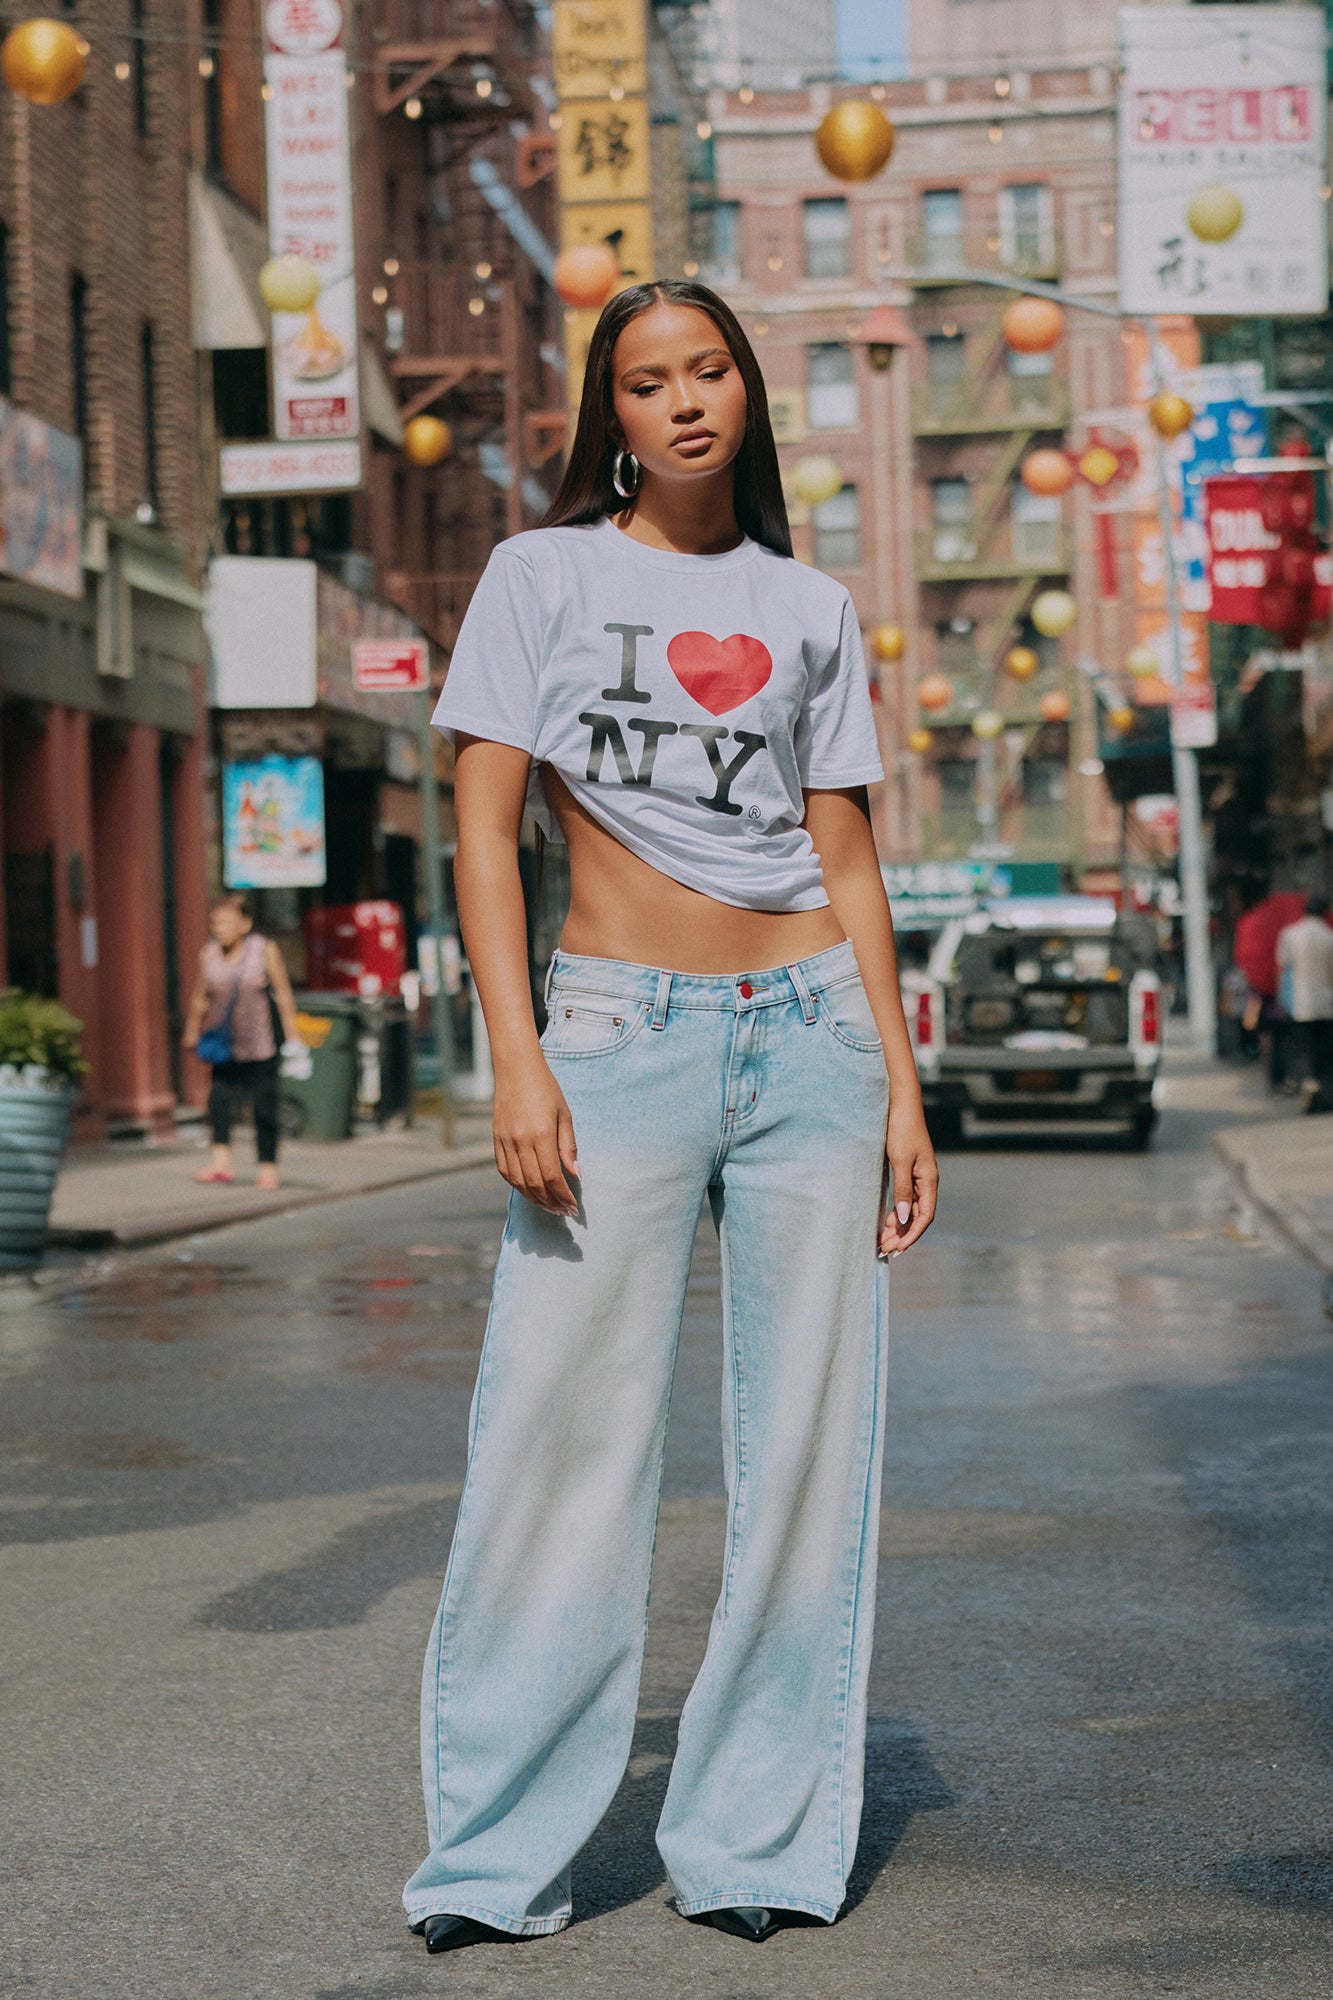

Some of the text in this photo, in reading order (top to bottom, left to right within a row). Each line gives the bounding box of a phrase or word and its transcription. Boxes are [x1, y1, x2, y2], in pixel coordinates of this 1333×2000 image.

[1138, 91, 1307, 140] PELL
[601, 623, 654, 704] I
[578, 712, 768, 816] NY
